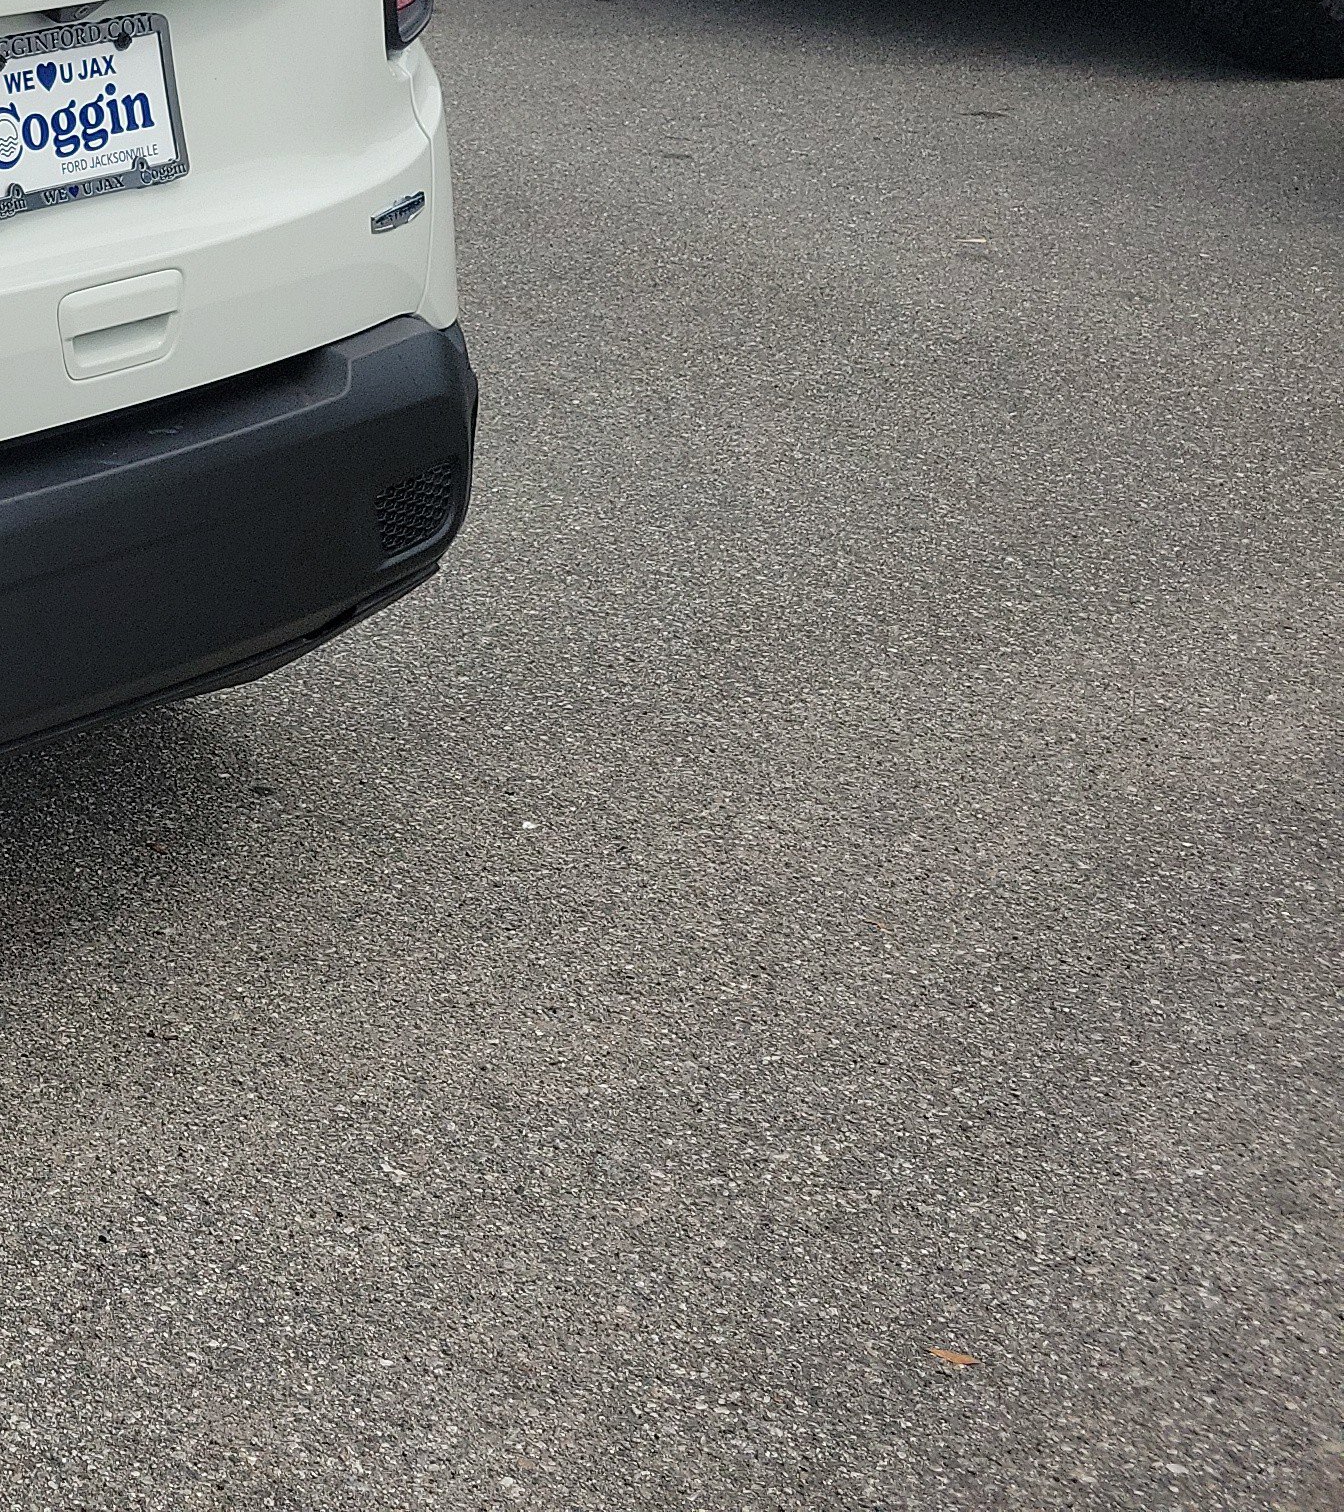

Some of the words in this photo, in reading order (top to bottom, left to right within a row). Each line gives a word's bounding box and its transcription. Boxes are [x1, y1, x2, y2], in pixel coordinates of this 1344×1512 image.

[3, 69, 36, 94] WE
[60, 62, 74, 83] U
[78, 55, 117, 80] JAX
[61, 158, 88, 175] FORD
[90, 144, 159, 168] JACKSONVILLE
[43, 189, 68, 205] WE
[82, 183, 97, 196] U
[97, 176, 126, 193] JAX
[140, 162, 188, 185] Coggin
